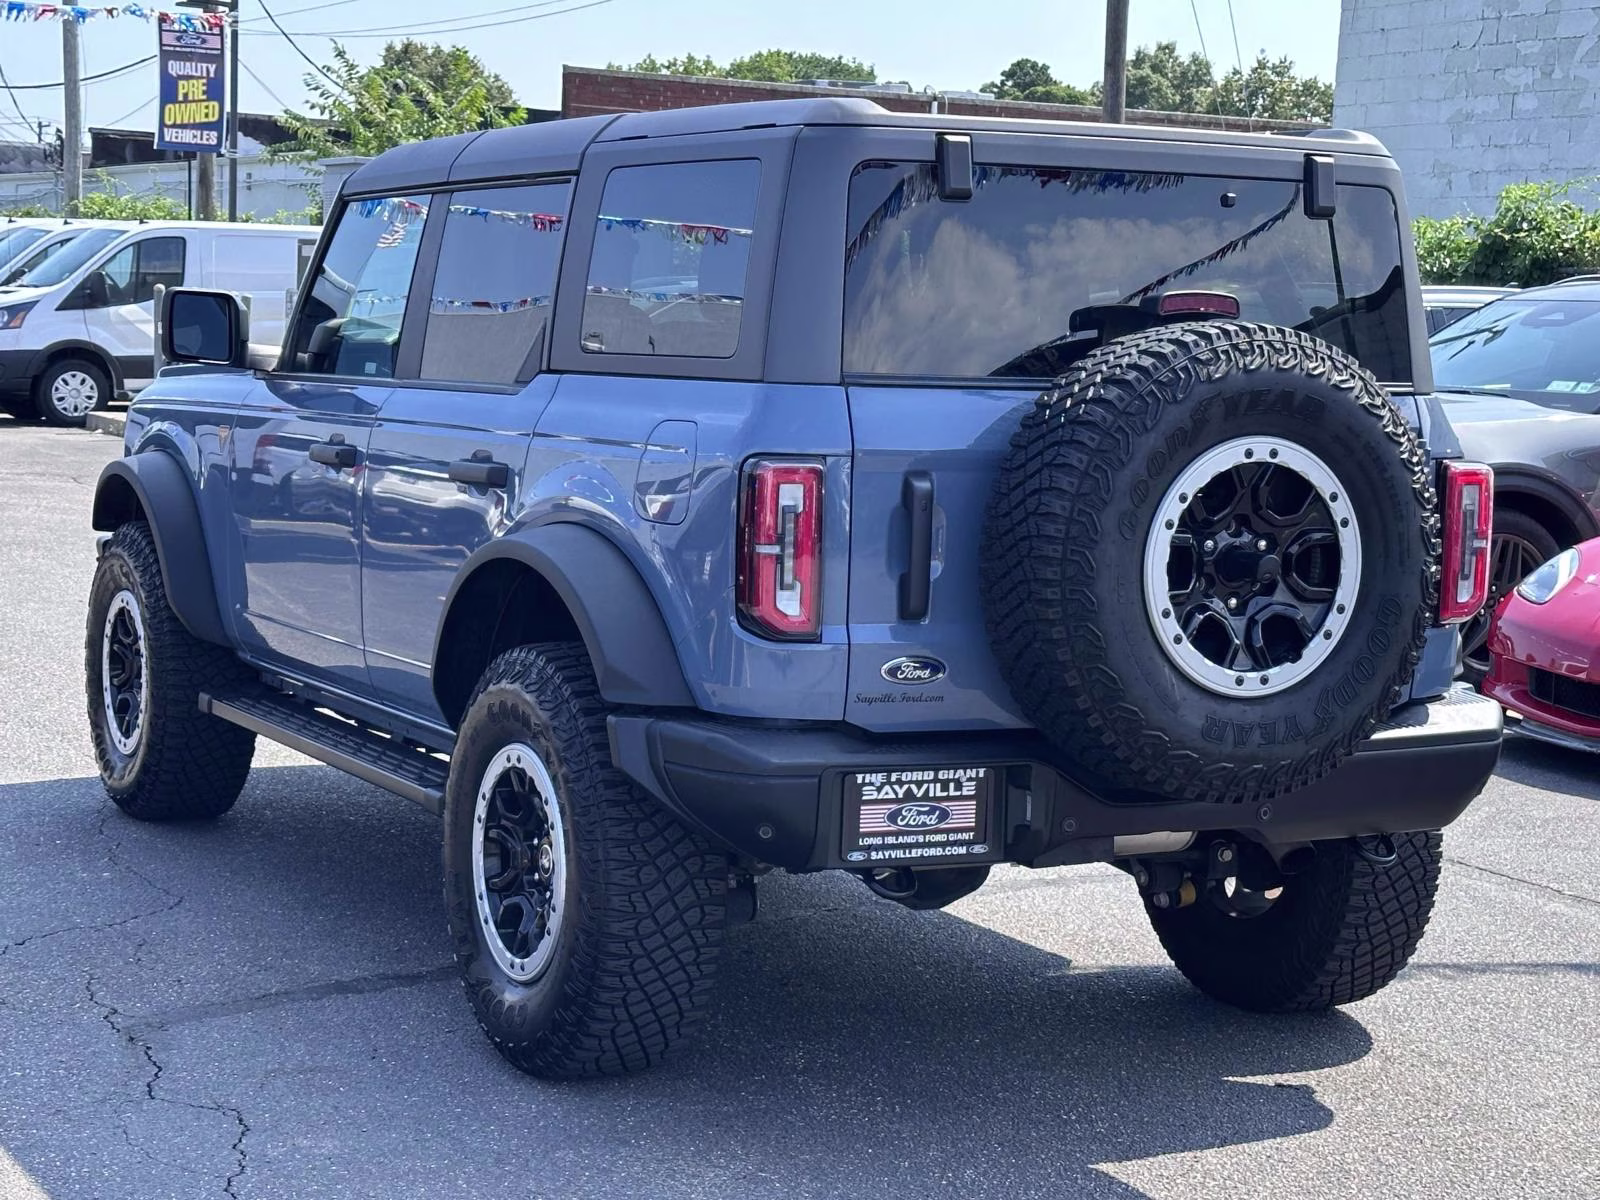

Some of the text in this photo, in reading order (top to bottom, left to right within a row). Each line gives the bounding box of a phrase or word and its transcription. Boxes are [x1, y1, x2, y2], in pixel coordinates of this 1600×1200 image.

[180, 34, 202, 45] Ford
[168, 60, 216, 77] QUALITY
[178, 79, 207, 101] PRE
[164, 101, 219, 126] OWNED
[163, 128, 218, 145] VEHICLES
[896, 661, 932, 679] Ford
[855, 767, 987, 784] THE FORD GIANT
[861, 781, 977, 800] SAYVILLE
[896, 805, 940, 826] Ford
[858, 831, 975, 846] LONG ISLAND'S FORD GIANT
[870, 845, 967, 860] SAYVILLEFORD.COM
